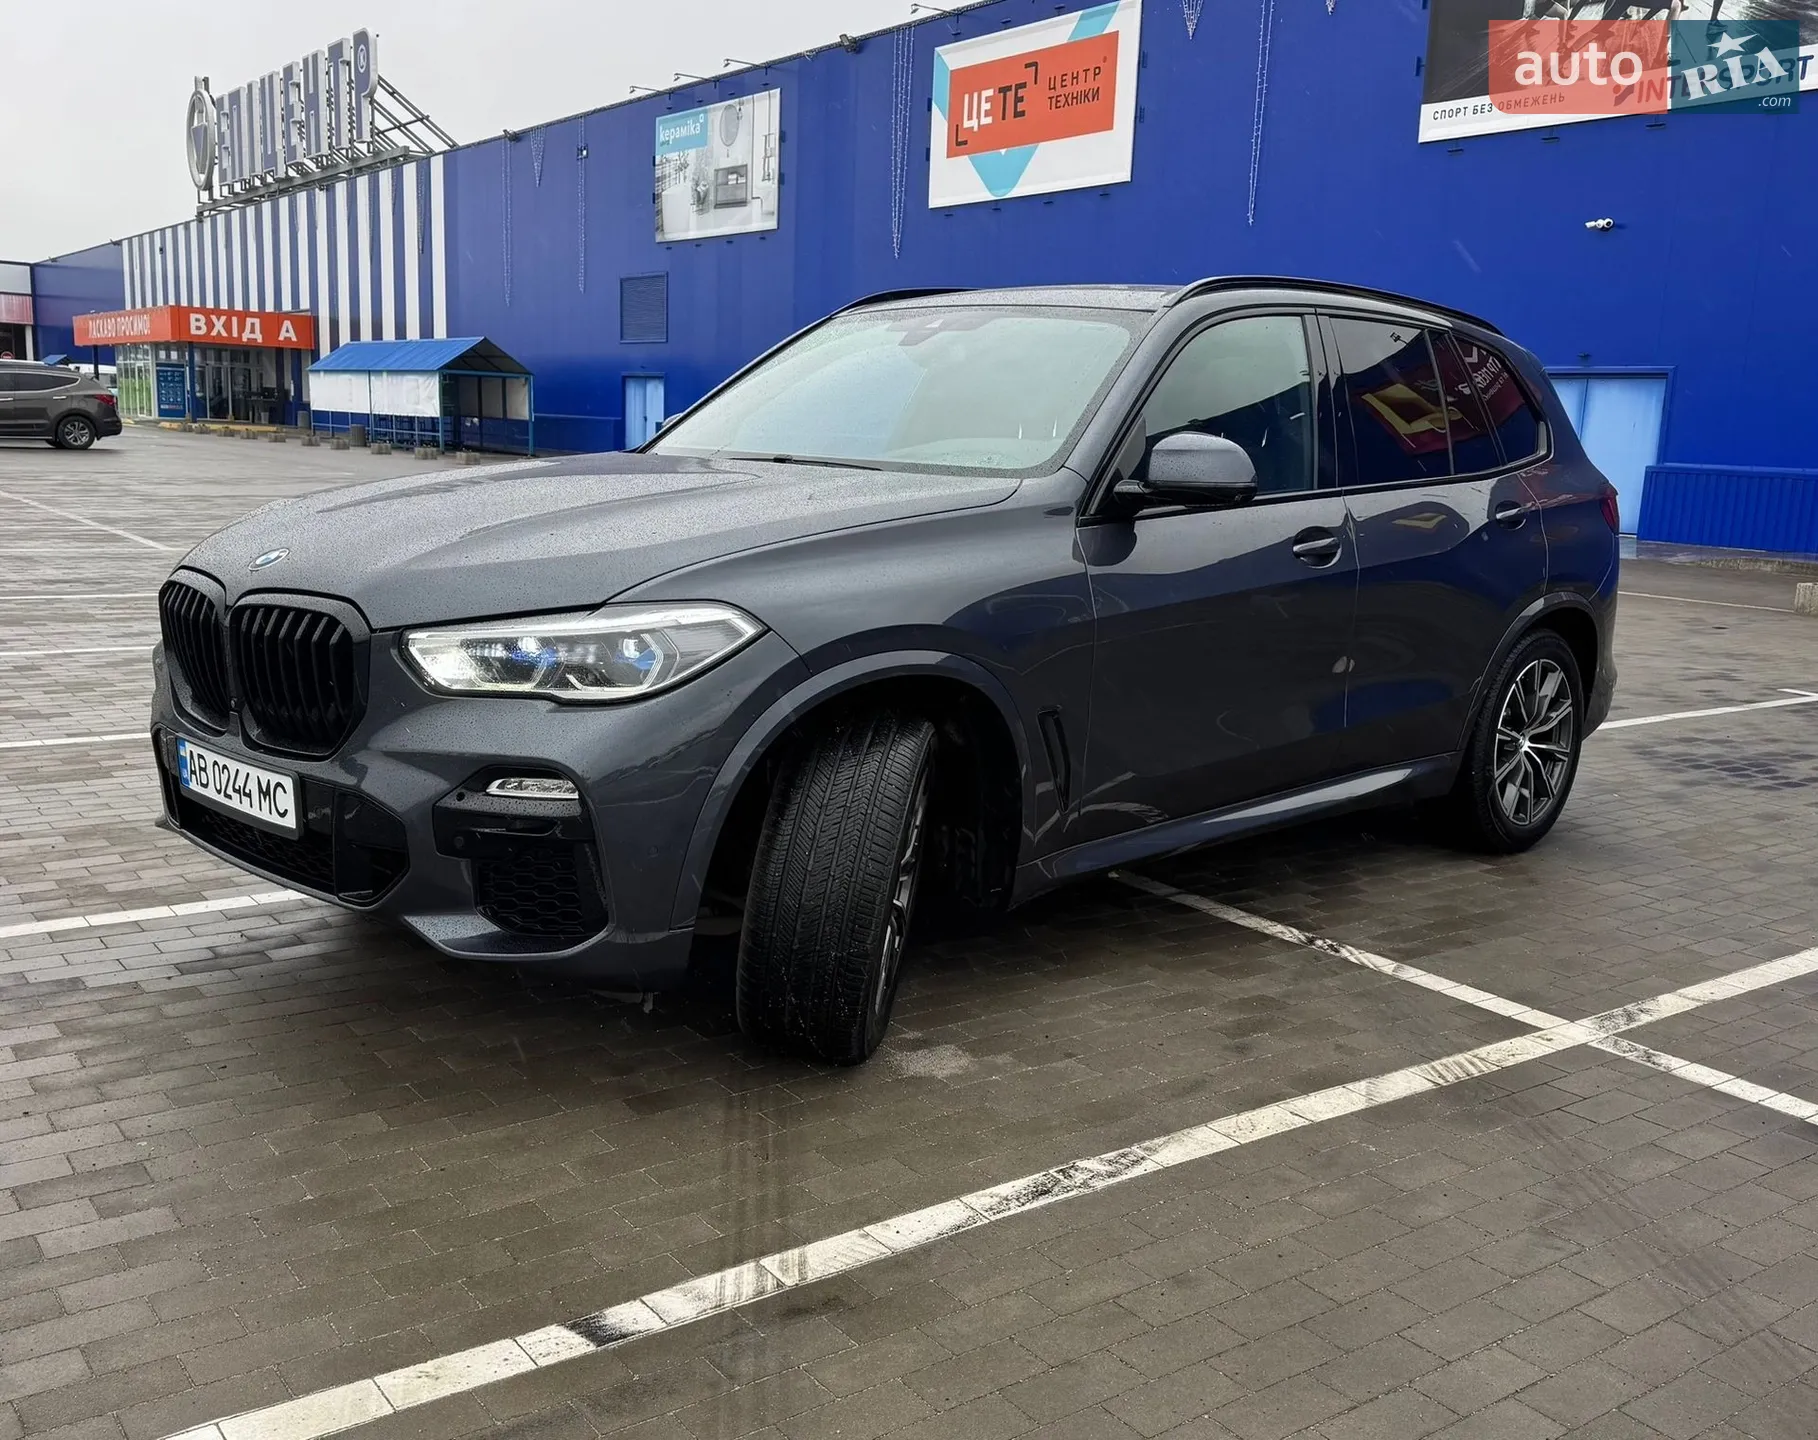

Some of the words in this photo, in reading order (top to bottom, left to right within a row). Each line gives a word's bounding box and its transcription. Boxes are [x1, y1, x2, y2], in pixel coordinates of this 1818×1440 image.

[1048, 66, 1101, 92] ЦЕНТР
[1637, 55, 1814, 104] INTESPRT
[216, 28, 378, 186] ЕПІЦЕНТР
[1047, 86, 1100, 110] ТЕХНІКИ
[1432, 106, 1468, 120] СПОРТ
[1472, 103, 1493, 115] БЕЗ
[1499, 92, 1565, 111] ОБМЕЖЕНЬ
[189, 313, 262, 343] ВХІД
[278, 320, 297, 341] А
[189, 750, 209, 788] AB
[212, 760, 253, 808] 0244
[257, 775, 288, 818] MC
